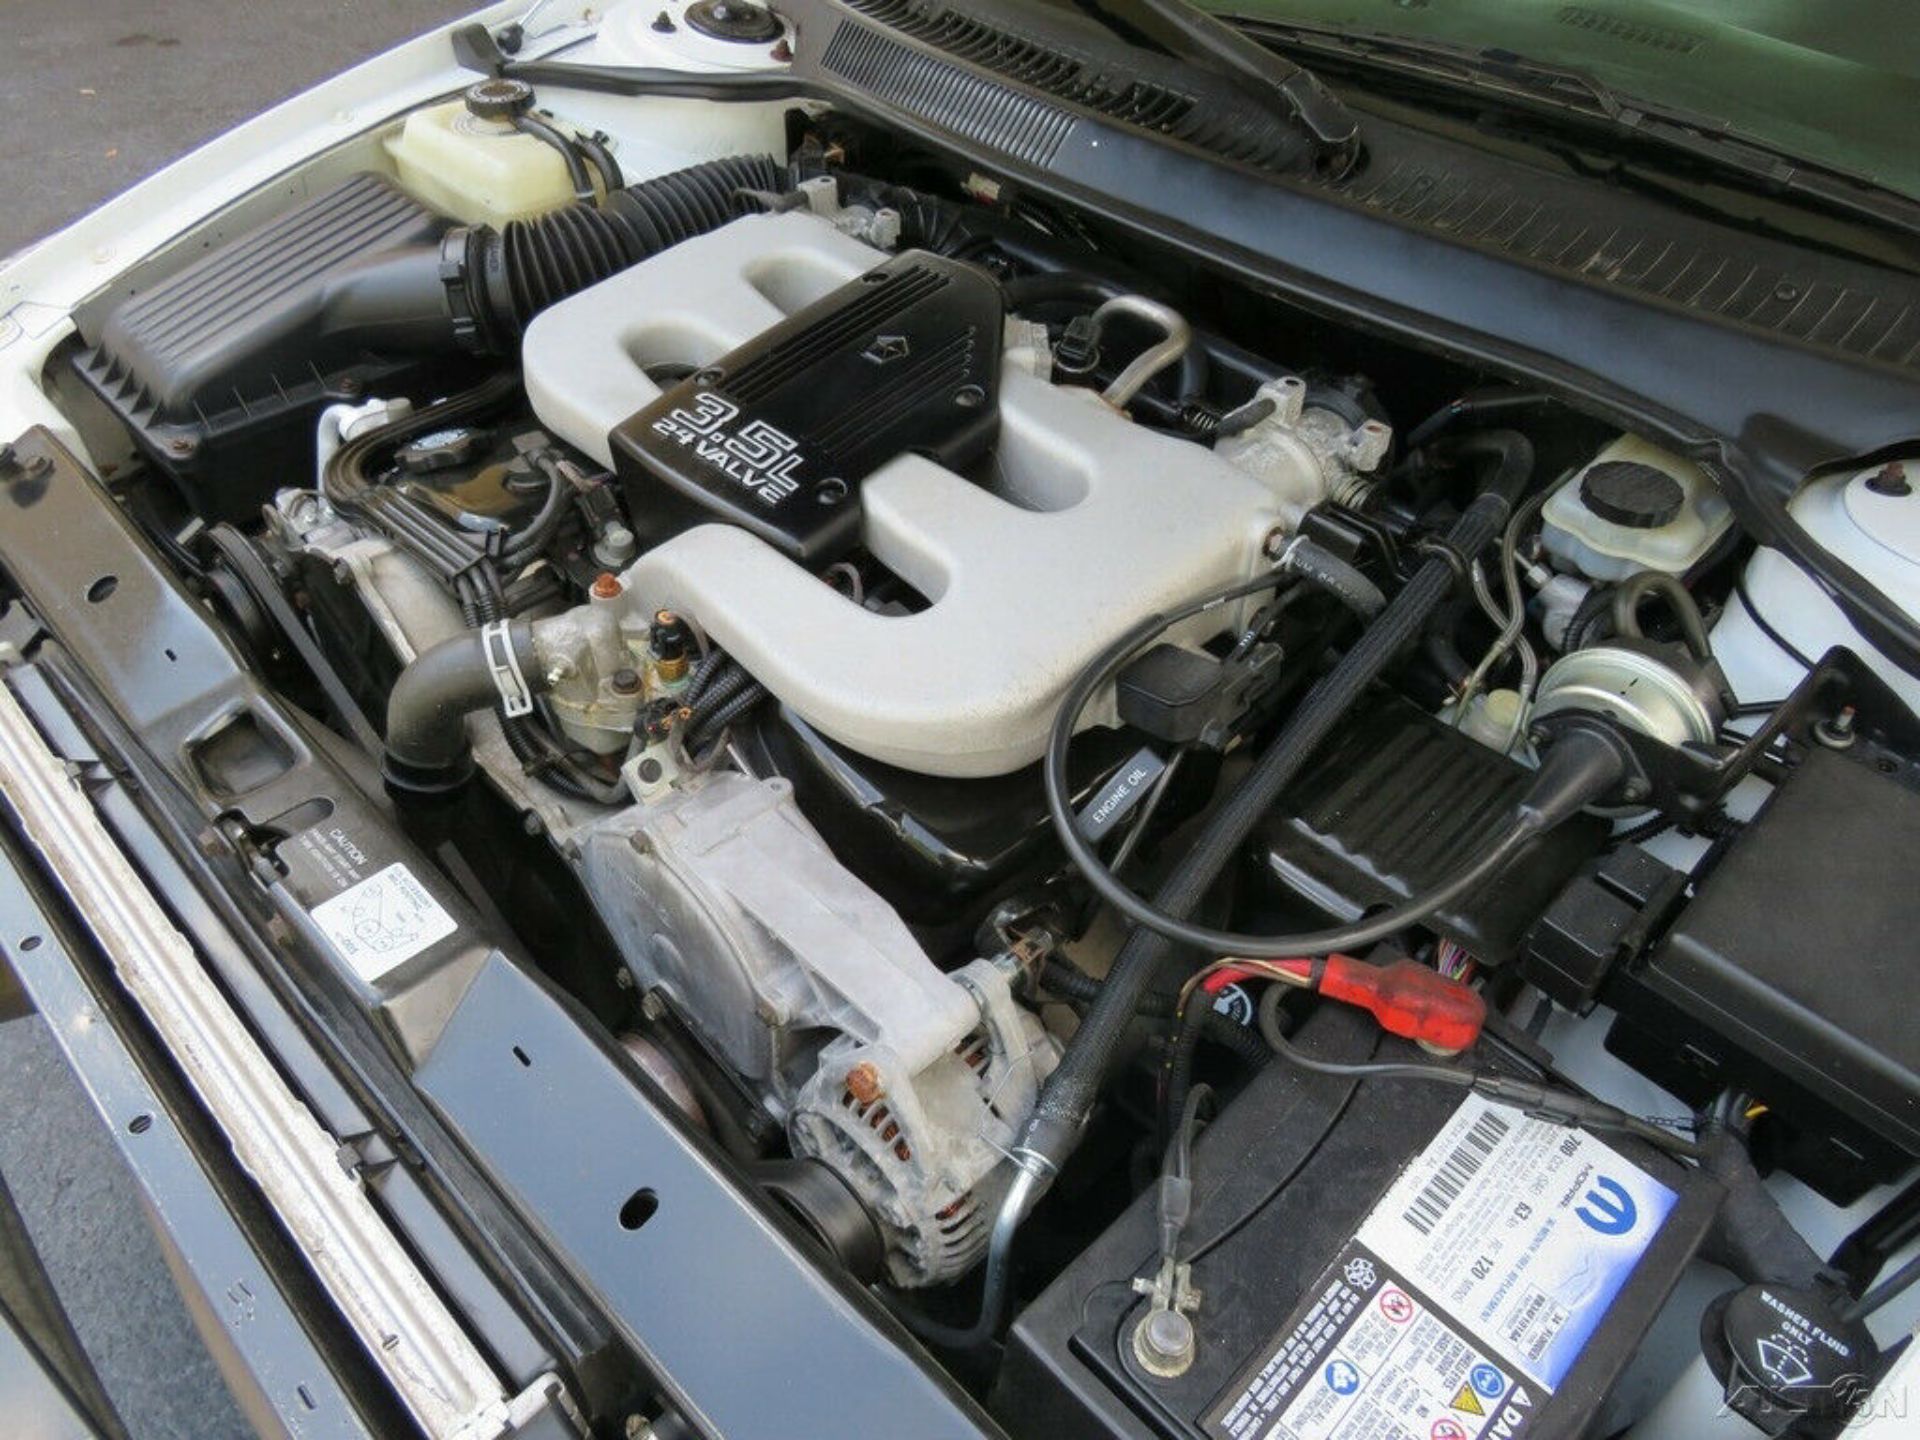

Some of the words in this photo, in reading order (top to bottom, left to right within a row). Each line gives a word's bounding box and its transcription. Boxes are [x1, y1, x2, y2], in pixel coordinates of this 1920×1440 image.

[652, 418, 697, 446] 24
[696, 440, 787, 504] VALVE
[671, 392, 804, 492] 3.5L
[1092, 784, 1130, 824] ENGINE
[1128, 769, 1147, 787] OIL
[329, 829, 368, 866] CAUTION
[1558, 1163, 1594, 1207] MOPAR
[1511, 1200, 1534, 1221] 63
[1468, 1253, 1495, 1281] 120
[1761, 1290, 1810, 1331] WASHER
[1811, 1326, 1850, 1357] FLUID
[1781, 1320, 1813, 1347] ONLY
[1487, 1405, 1523, 1440] DA
